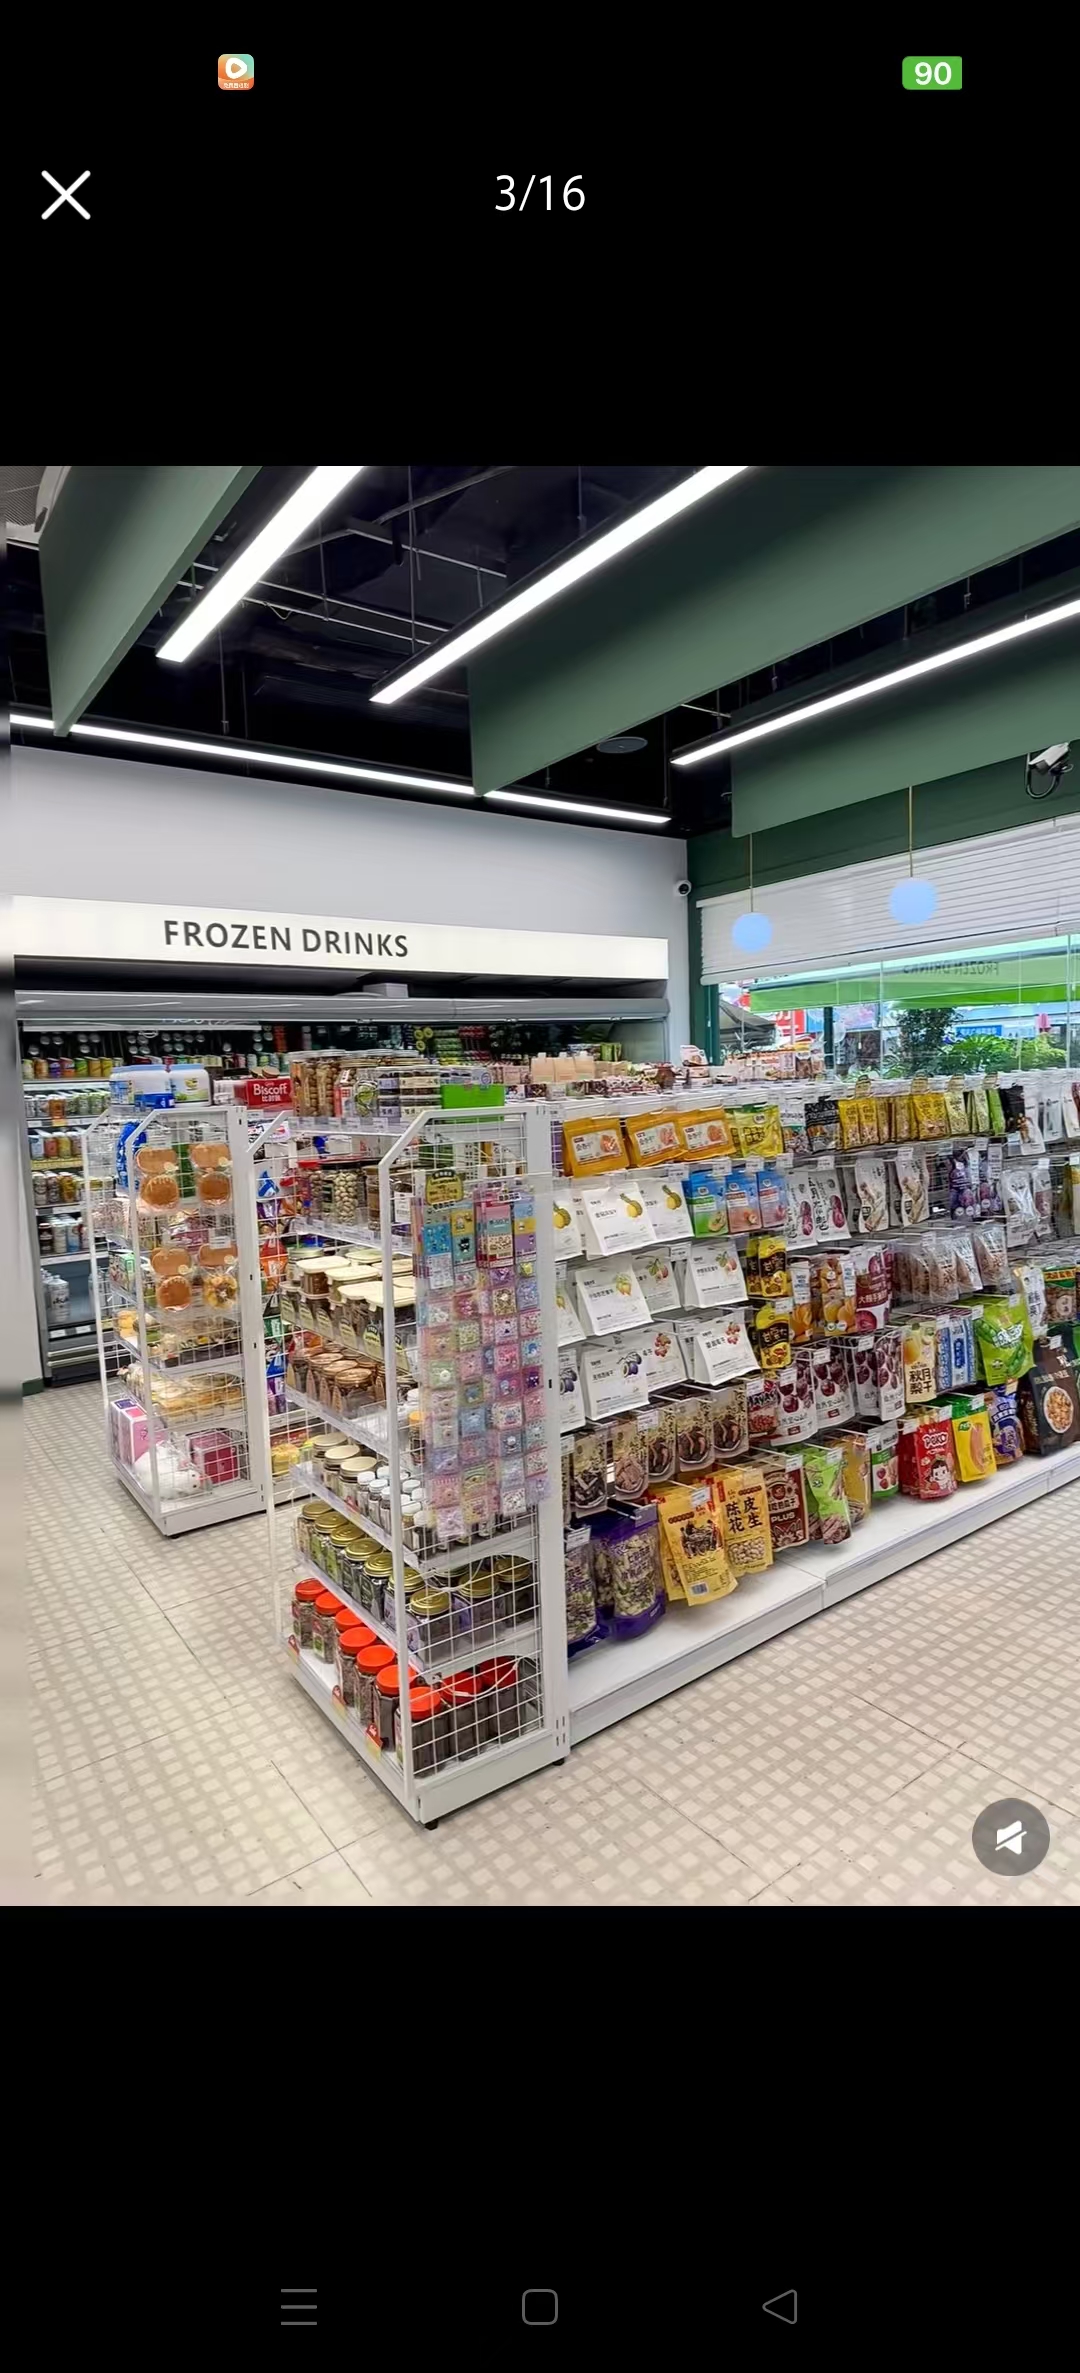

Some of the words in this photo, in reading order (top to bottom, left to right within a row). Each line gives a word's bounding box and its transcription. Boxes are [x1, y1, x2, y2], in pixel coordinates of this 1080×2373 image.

[163, 919, 292, 951] FROZEN
[302, 928, 409, 958] DRINKS
[253, 1083, 288, 1096] Biscoff
[725, 1496, 759, 1518] 陈皮
[770, 1511, 796, 1523] PLUS
[729, 1511, 763, 1533] 花生
